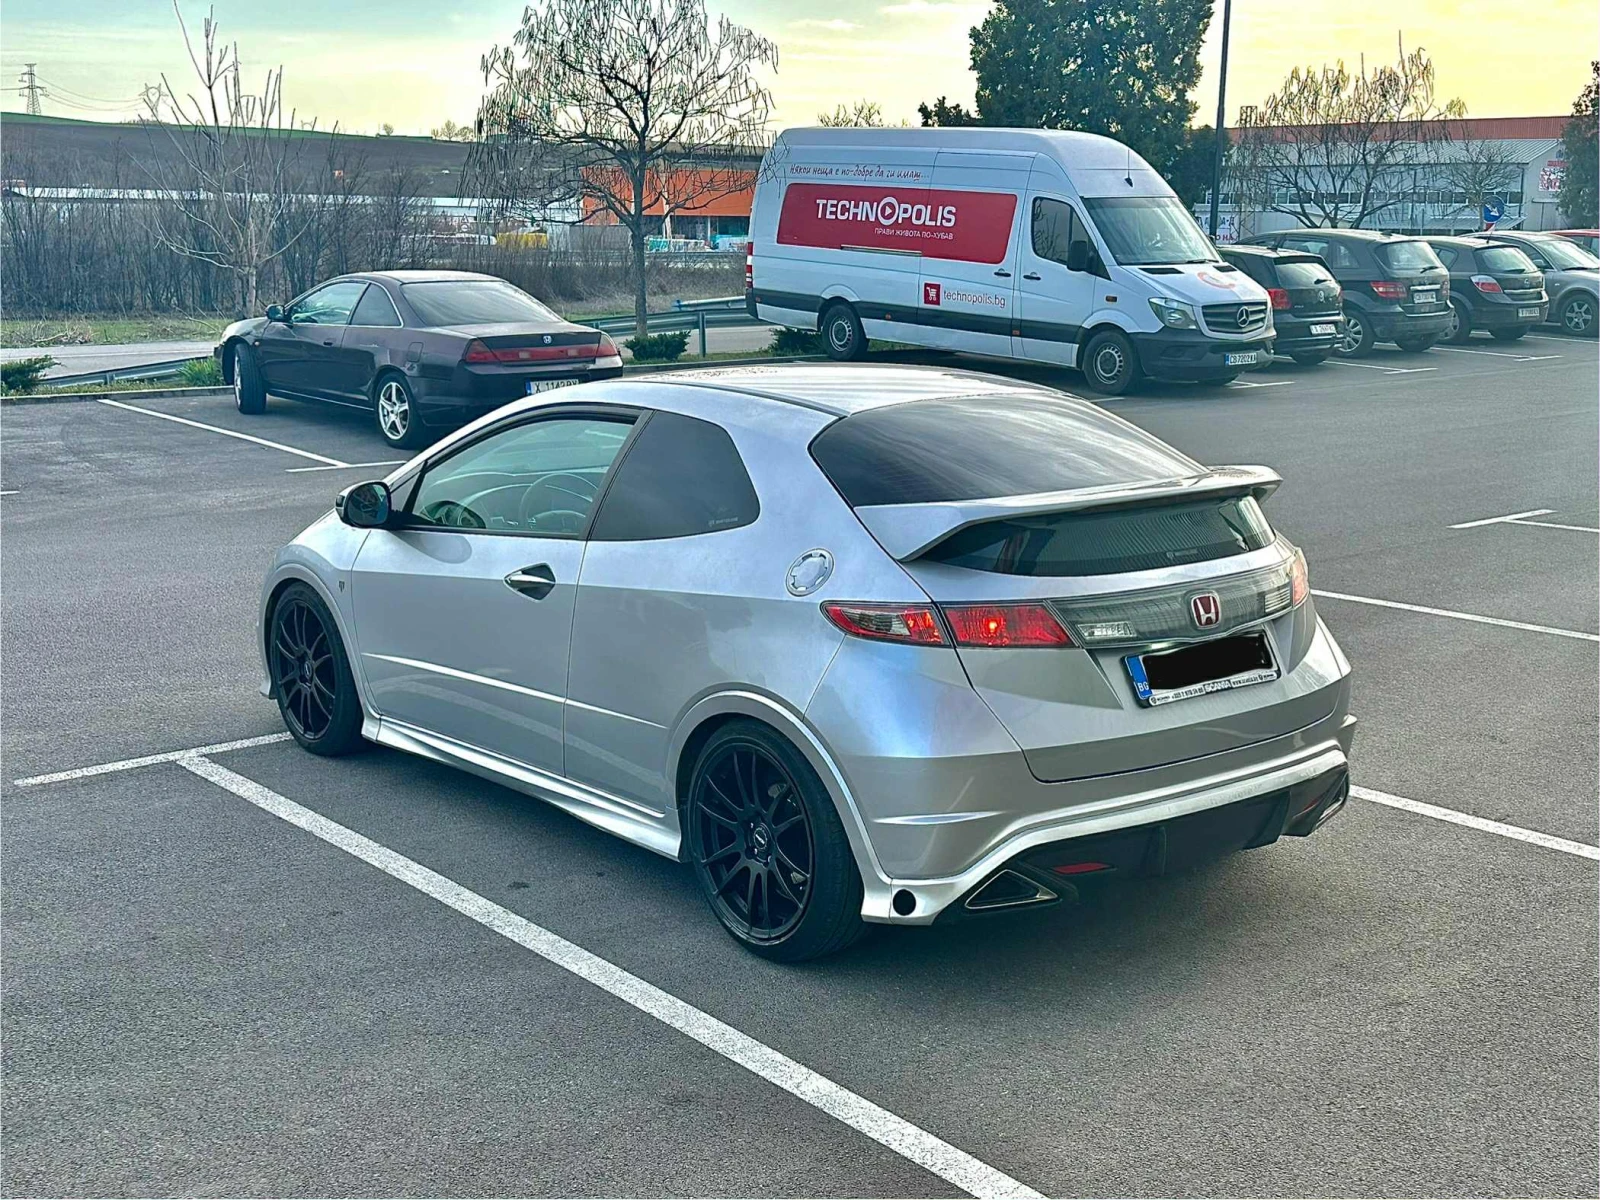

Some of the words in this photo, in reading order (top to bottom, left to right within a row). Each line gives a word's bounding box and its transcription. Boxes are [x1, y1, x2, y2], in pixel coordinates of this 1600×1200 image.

[790, 163, 811, 175] Някои
[813, 167, 833, 177] неща
[835, 168, 840, 176] е
[841, 164, 874, 182] по-добре
[875, 164, 884, 177] да
[886, 169, 895, 178] ги
[816, 196, 957, 227] TECHNOPOLIS
[874, 227, 895, 236] ПРАВИ
[895, 229, 921, 238] ЖИВОТА
[922, 231, 954, 240] ПО-ХУБАВ
[943, 289, 1006, 308] technopolis.bg
[1137, 682, 1150, 692] BG
[1204, 680, 1231, 693] SCANIA
